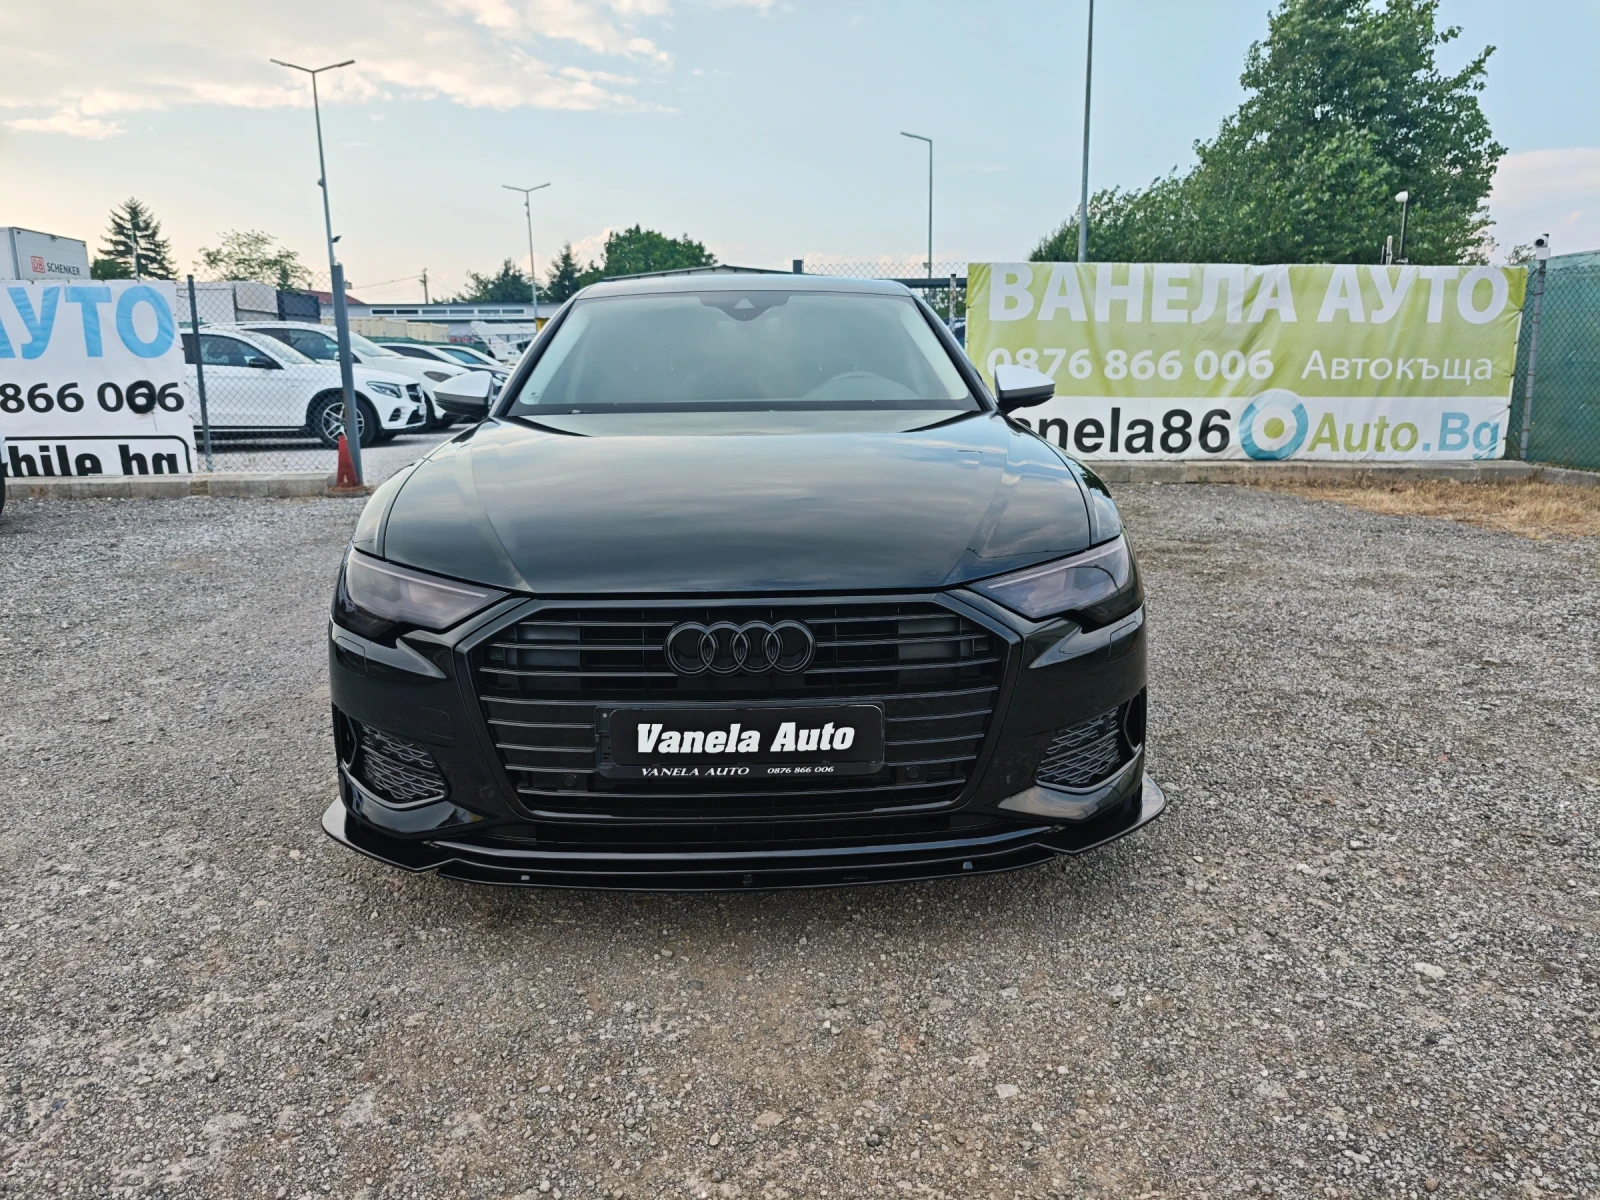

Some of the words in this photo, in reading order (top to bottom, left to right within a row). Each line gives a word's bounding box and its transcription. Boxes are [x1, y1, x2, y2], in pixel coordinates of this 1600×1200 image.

[32, 257, 44, 271] DB
[46, 262, 81, 276] SCHENKER
[989, 263, 1297, 324] ВАНЕЛА
[1317, 265, 1510, 324] АУТО
[986, 347, 1092, 379] 0876
[1103, 349, 1183, 381] 866
[1194, 349, 1275, 381] 006
[1300, 349, 1493, 386] Автокъща
[0, 382, 85, 414] 866
[637, 722, 761, 754] Vanela
[770, 721, 855, 752] Auto
[641, 767, 700, 777] VANELA
[704, 766, 750, 776] AUTO
[767, 767, 792, 775] 0876
[793, 766, 812, 774] 866
[814, 765, 835, 773] 006
